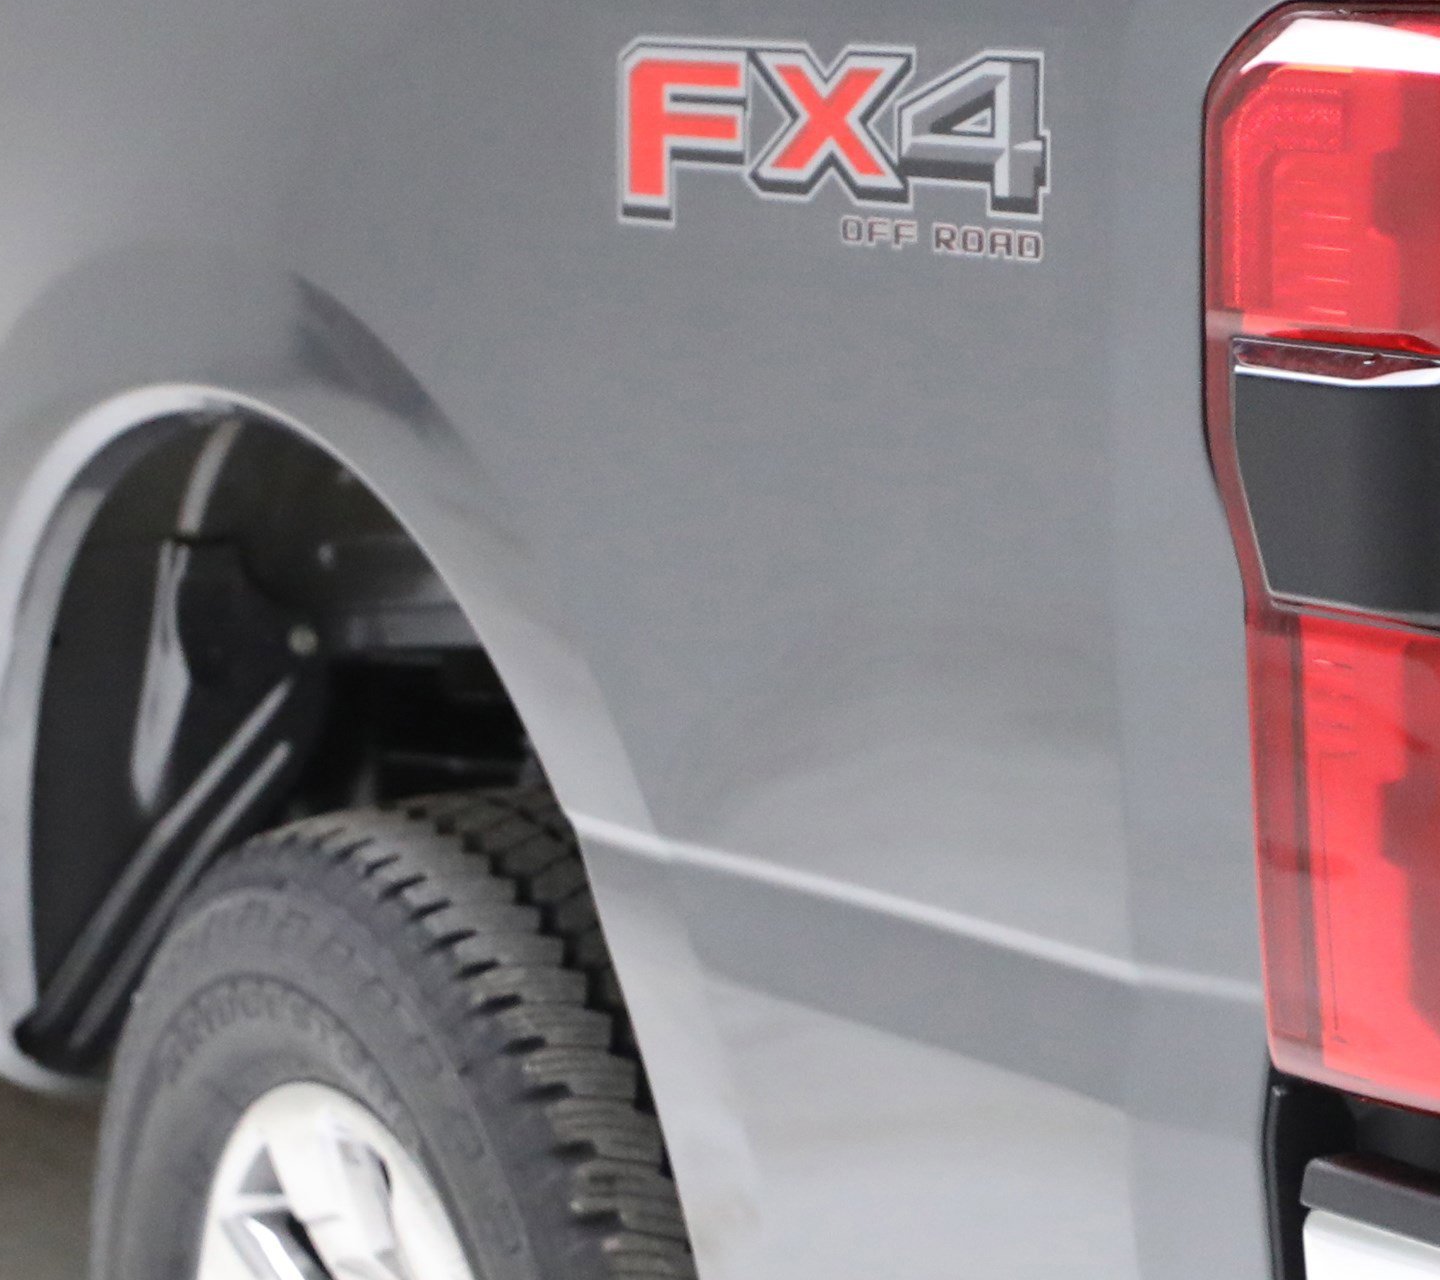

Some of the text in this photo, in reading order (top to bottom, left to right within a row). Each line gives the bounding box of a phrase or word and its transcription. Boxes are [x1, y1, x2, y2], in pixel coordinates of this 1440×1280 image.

[618, 36, 1051, 229] FX4
[840, 215, 1044, 263] OFF ROAD
